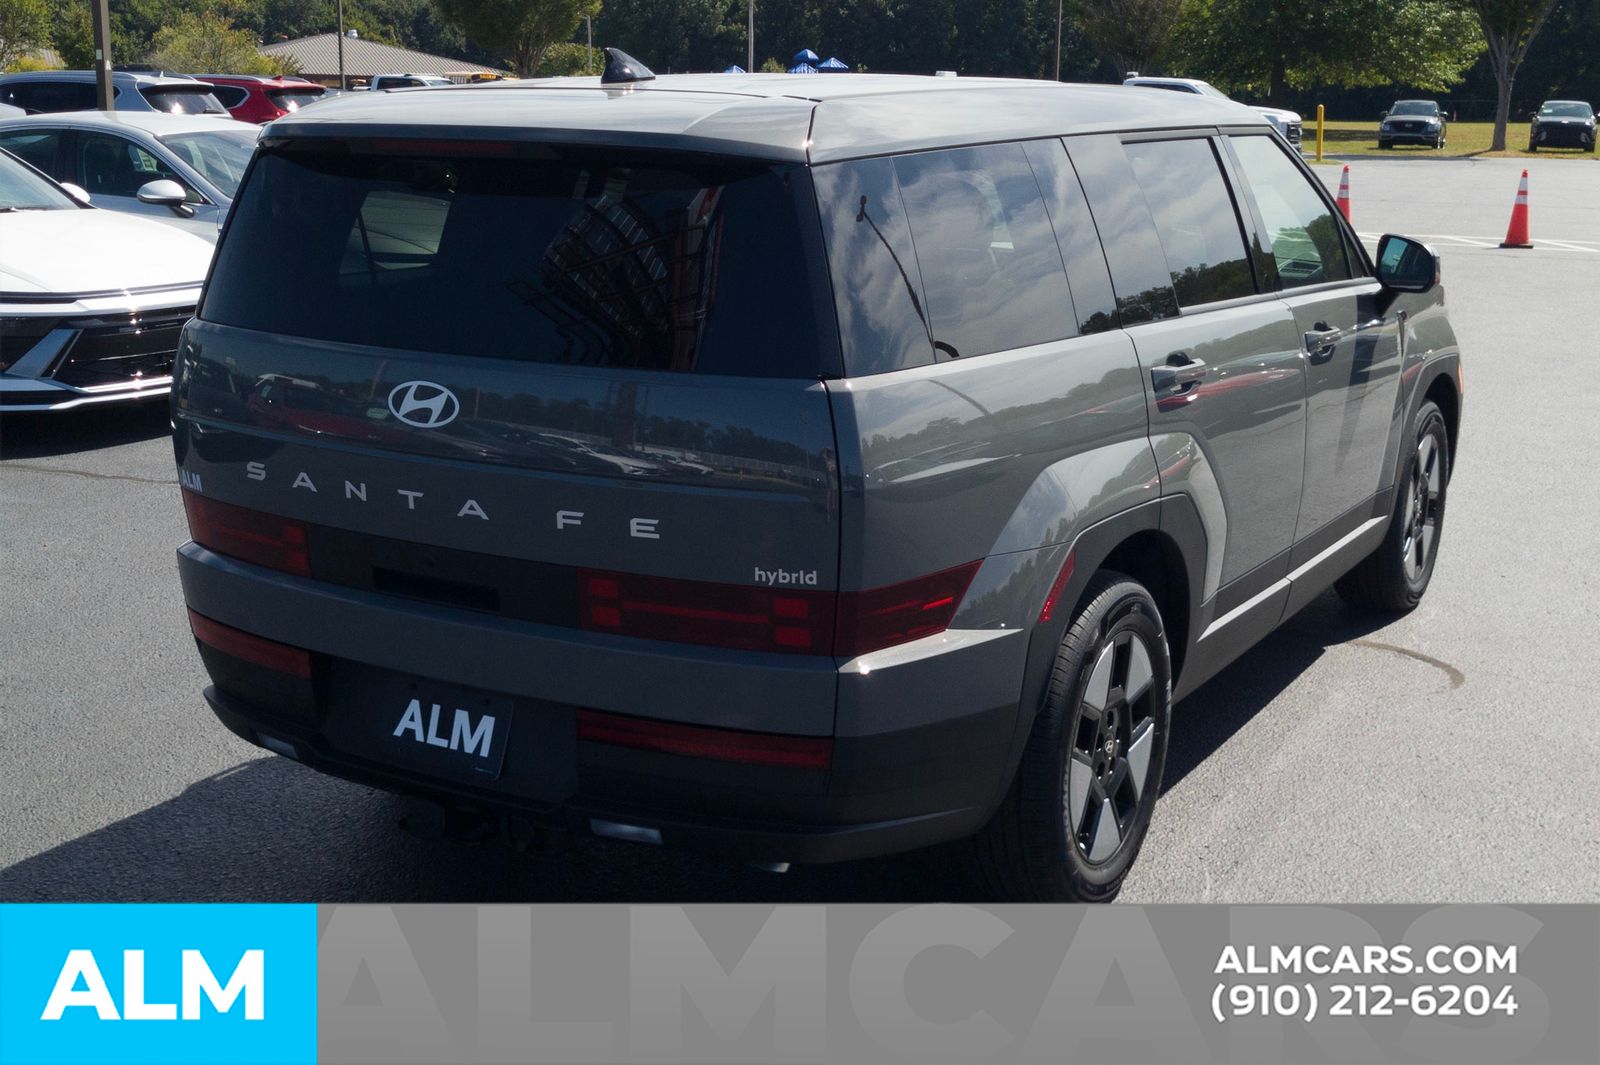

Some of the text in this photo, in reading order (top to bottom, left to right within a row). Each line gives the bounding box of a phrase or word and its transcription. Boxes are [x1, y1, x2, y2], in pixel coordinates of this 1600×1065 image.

[246, 461, 660, 539] SANTA FE
[754, 566, 817, 586] hybrid
[392, 698, 496, 758] ALM
